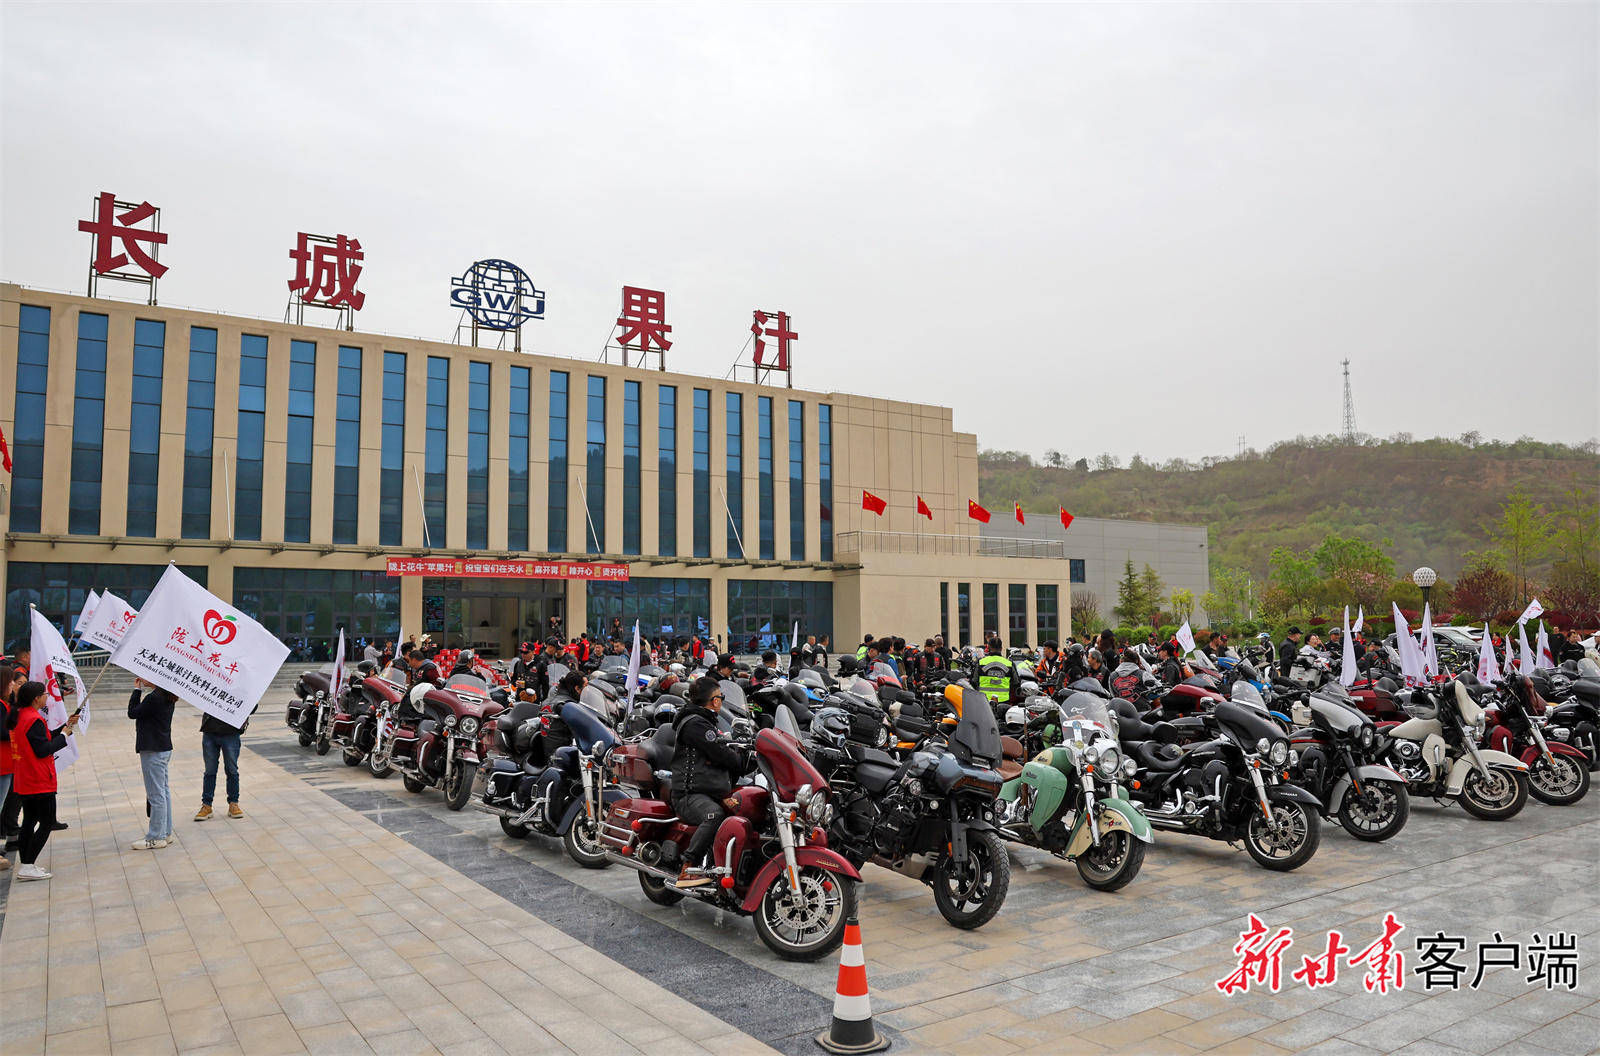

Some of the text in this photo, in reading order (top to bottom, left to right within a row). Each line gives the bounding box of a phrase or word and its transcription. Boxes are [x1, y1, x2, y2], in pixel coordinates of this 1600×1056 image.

[450, 288, 545, 314] GWJ
[133, 657, 159, 673] Tianshui
[170, 626, 239, 675] 陇上花牛
[138, 647, 243, 708] 天水长城果汁饮料有限公司
